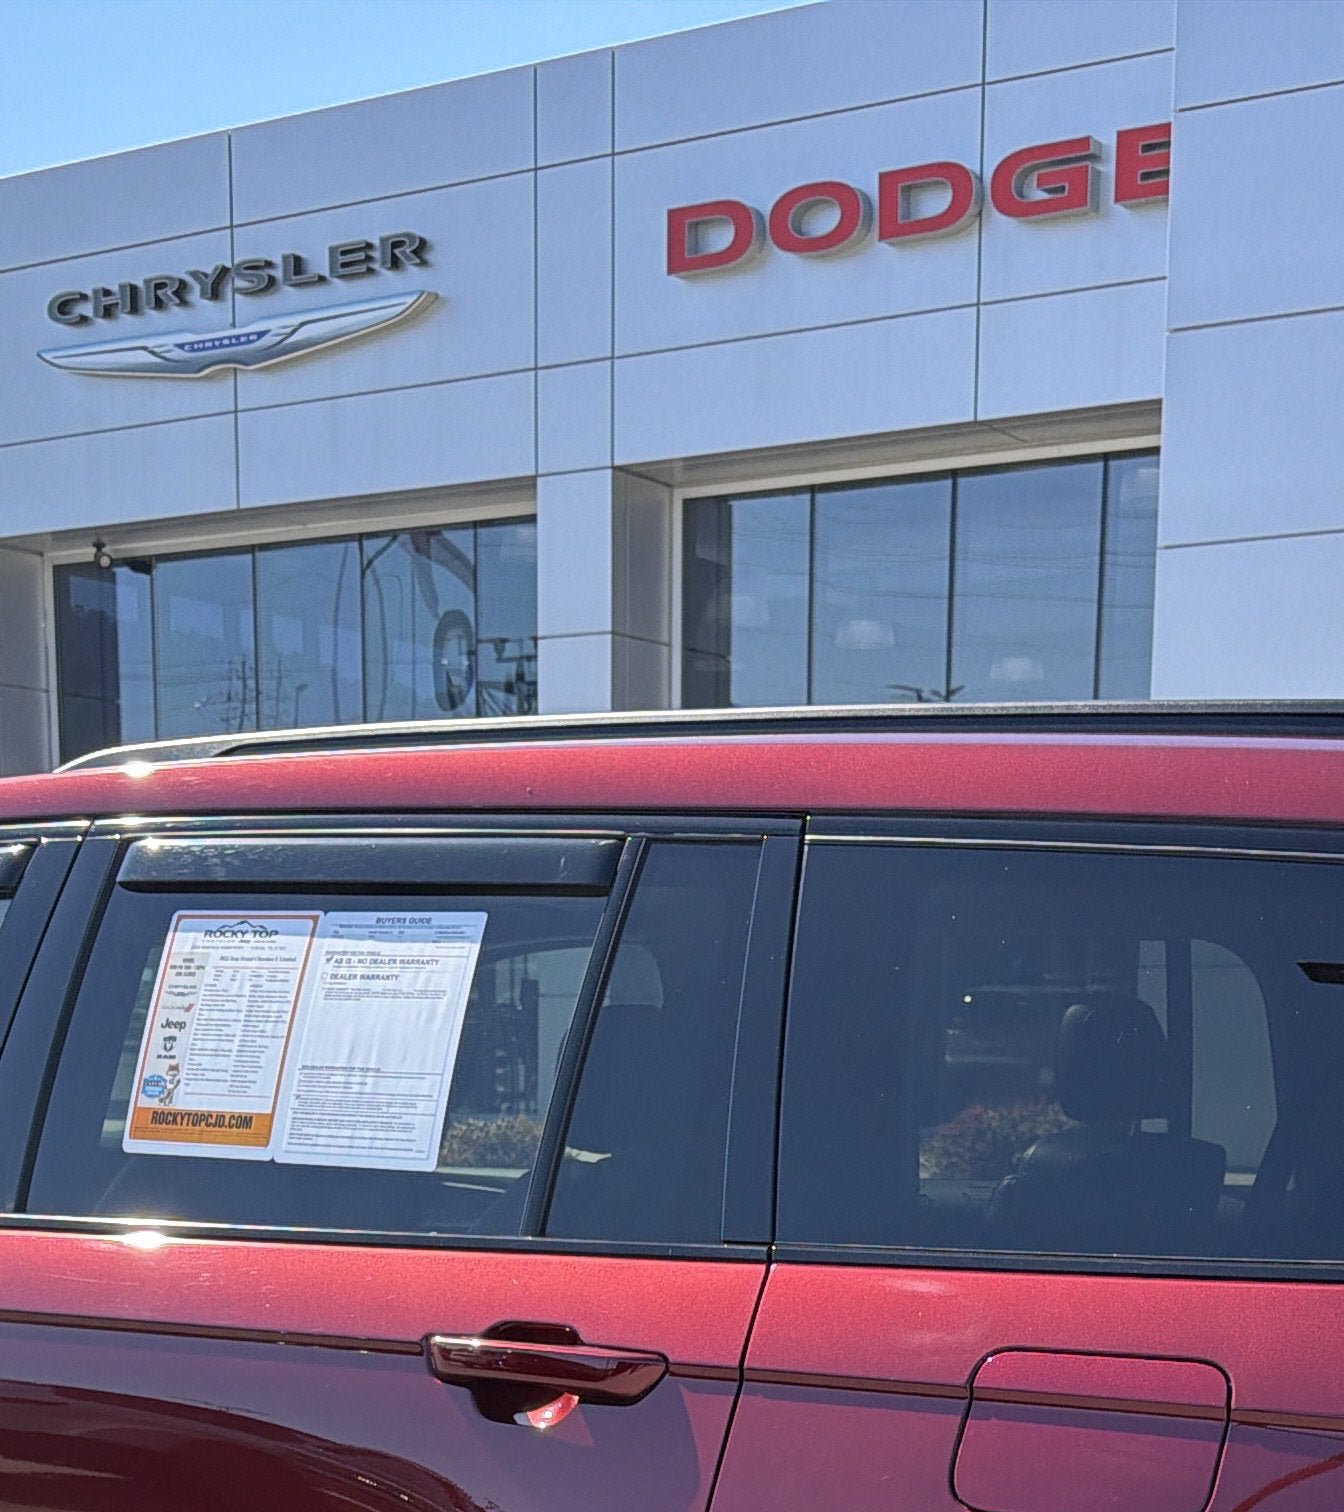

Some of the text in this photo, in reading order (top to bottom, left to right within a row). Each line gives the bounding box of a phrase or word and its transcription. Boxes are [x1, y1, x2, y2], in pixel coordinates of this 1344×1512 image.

[667, 122, 1171, 276] DODGE
[47, 231, 430, 325] CHRYSLER
[183, 333, 259, 351] CHRYSLER
[375, 916, 433, 925] BUYERS GUIDE
[203, 929, 279, 939] ROCKY TOP
[369, 958, 397, 966] DEALER
[330, 972, 358, 981] DEALER
[160, 1017, 187, 1032] Jeep
[150, 1110, 253, 1130] ROCKYTOPCJD.COM
